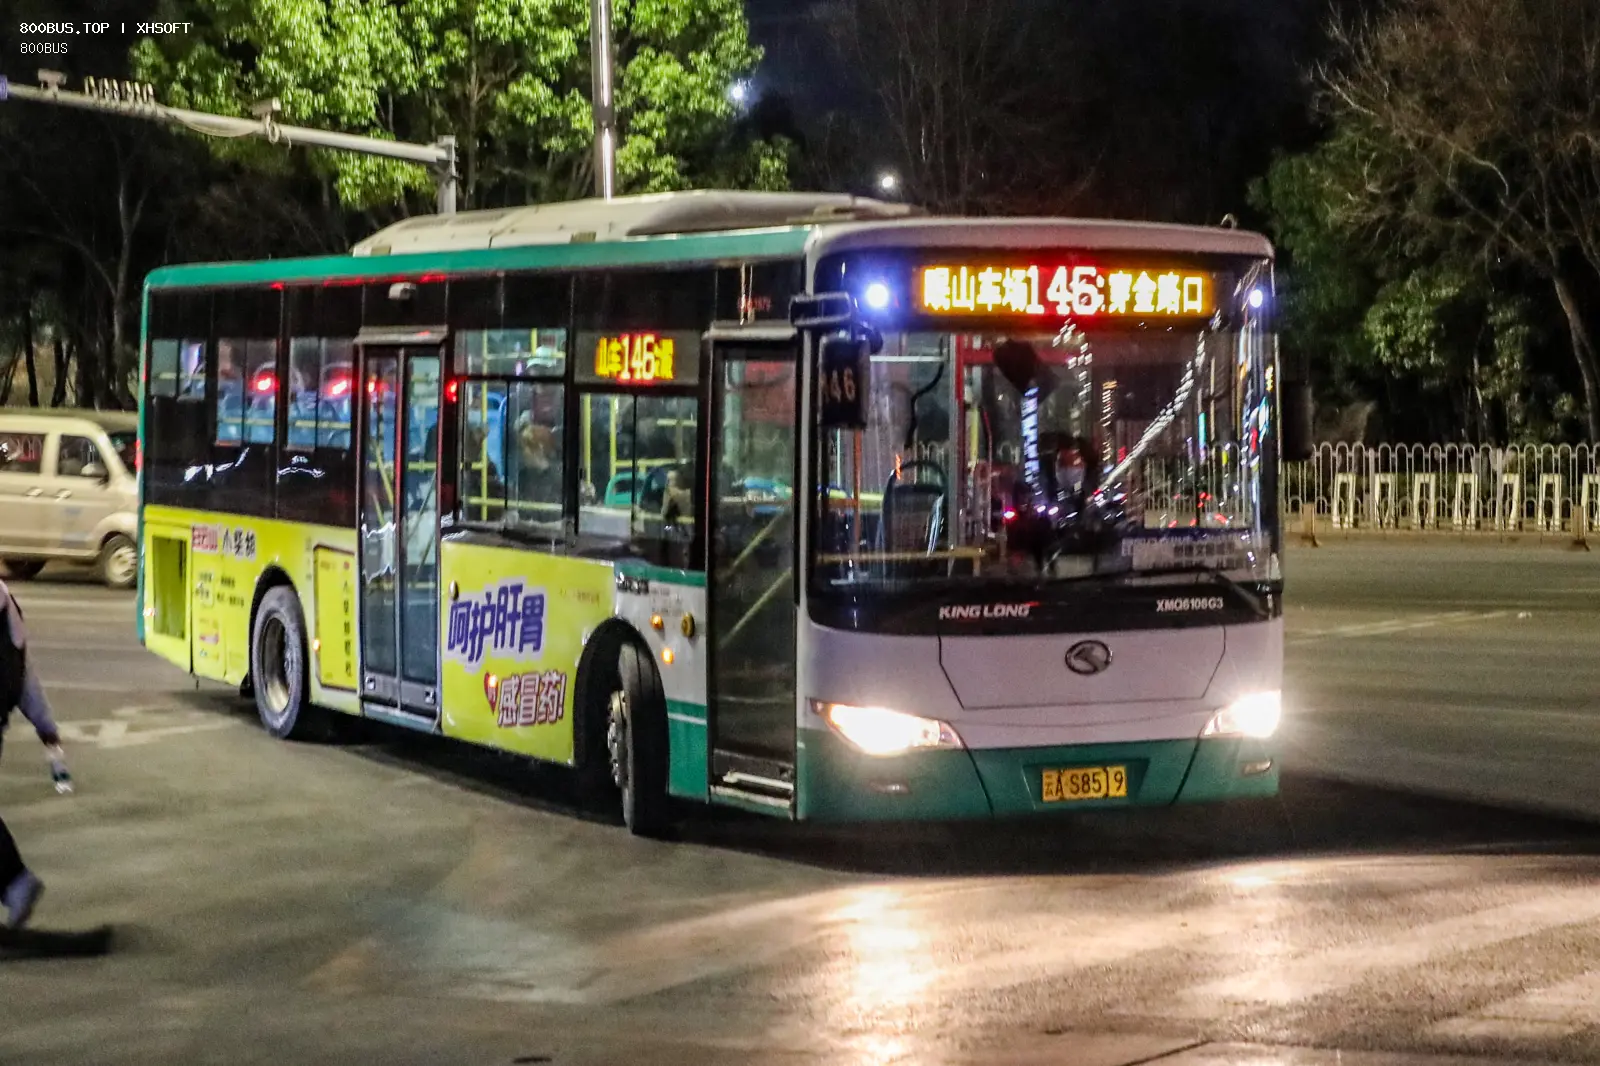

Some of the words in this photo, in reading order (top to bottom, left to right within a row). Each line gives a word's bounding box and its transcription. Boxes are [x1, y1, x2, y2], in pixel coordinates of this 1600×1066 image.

[1026, 264, 1098, 316] 146
[619, 332, 656, 381] 146
[447, 583, 545, 663] 呵护肝胃
[939, 605, 981, 620] KING
[983, 603, 1030, 618] LONG
